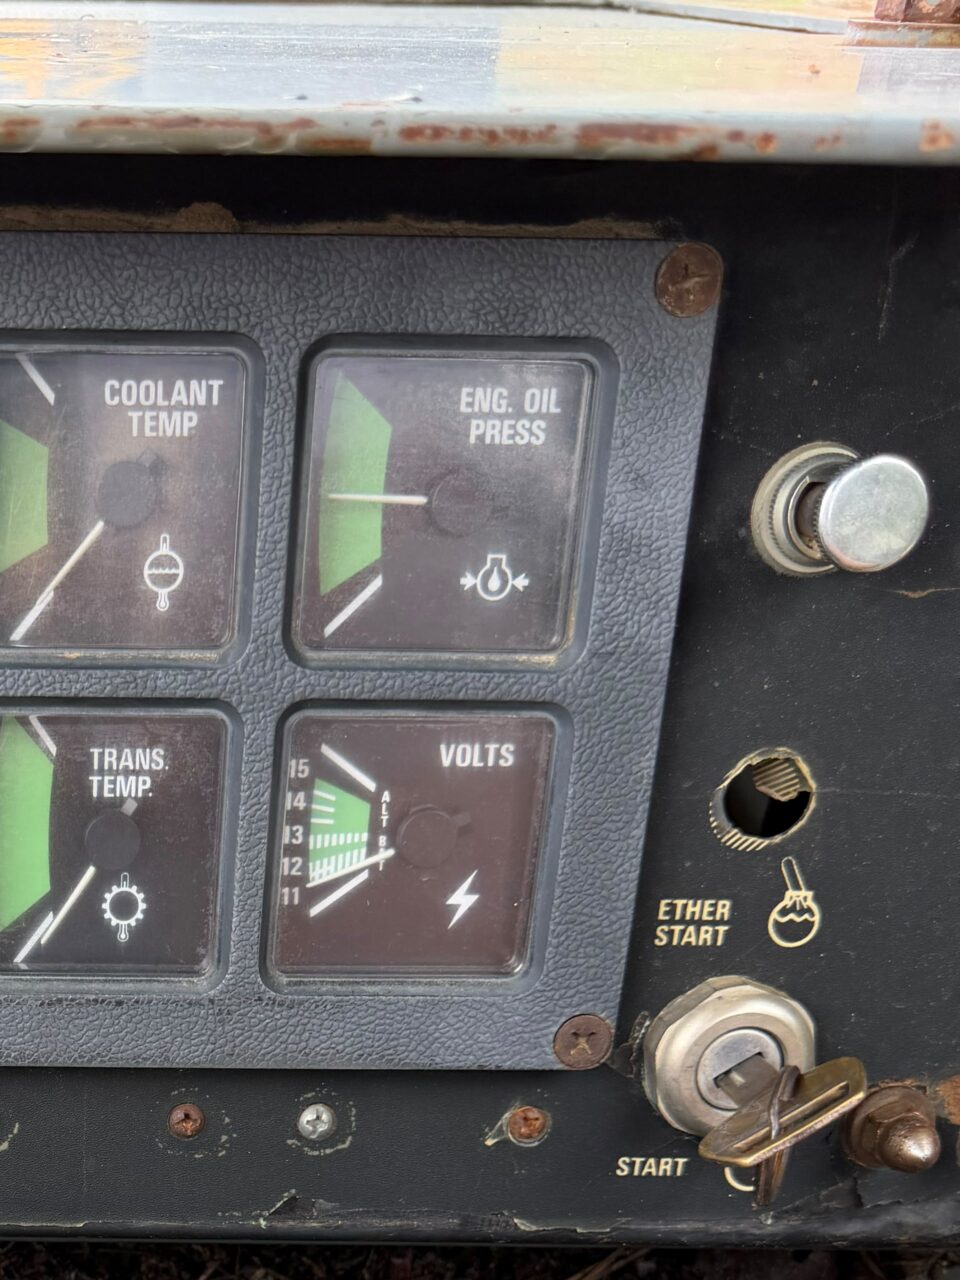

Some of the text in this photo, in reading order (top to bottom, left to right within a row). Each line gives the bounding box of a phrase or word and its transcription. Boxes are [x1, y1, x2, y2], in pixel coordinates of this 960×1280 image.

[104, 379, 224, 406] COOLANT
[460, 387, 561, 413] ENG. OIL
[128, 411, 198, 437] TEMP
[469, 419, 546, 445] PRESS
[90, 747, 169, 771] TRANS.
[440, 743, 515, 768] VOLTS
[289, 759, 309, 778] 15
[89, 775, 153, 798] TEMP.
[286, 791, 306, 811] 14
[381, 790, 390, 828] ALT
[283, 825, 304, 845] 13
[378, 835, 387, 872] BT
[282, 857, 302, 876] 12
[281, 887, 300, 905] 11
[657, 899, 731, 922] ETHER
[654, 926, 728, 947] START
[616, 1157, 688, 1177] START
